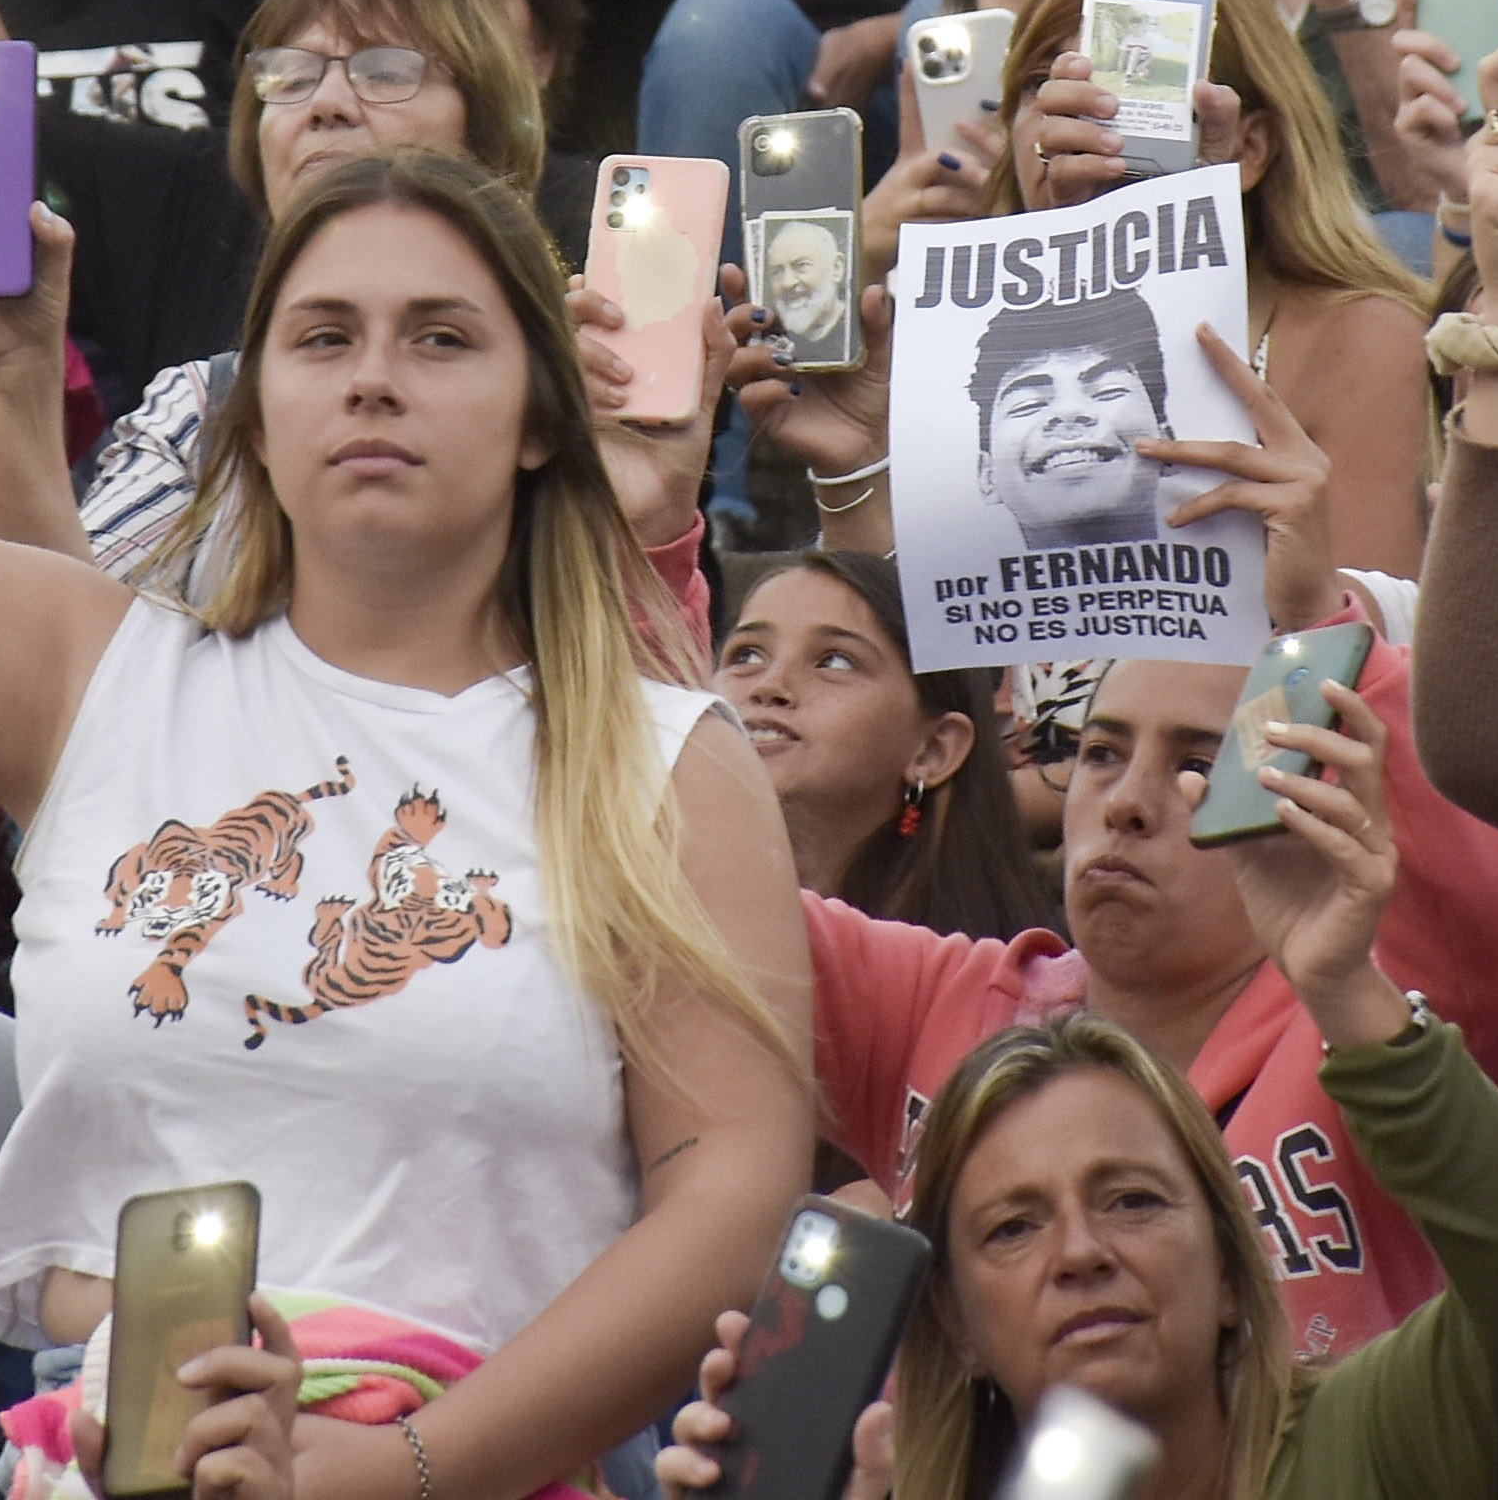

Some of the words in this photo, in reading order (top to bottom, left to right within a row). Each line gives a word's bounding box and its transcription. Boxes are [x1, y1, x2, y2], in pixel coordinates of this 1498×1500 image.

[915, 196, 1228, 308] JUSTICIA
[935, 575, 989, 602] por
[1000, 543, 1231, 592] FERNANDO
[946, 604, 972, 624] SI
[981, 600, 1022, 620] NO
[1033, 596, 1069, 616] ES
[1079, 589, 1228, 616] PERPETUA
[975, 624, 1018, 645] NO
[1029, 620, 1067, 641] ES
[1075, 615, 1207, 640] JUSTICIA
